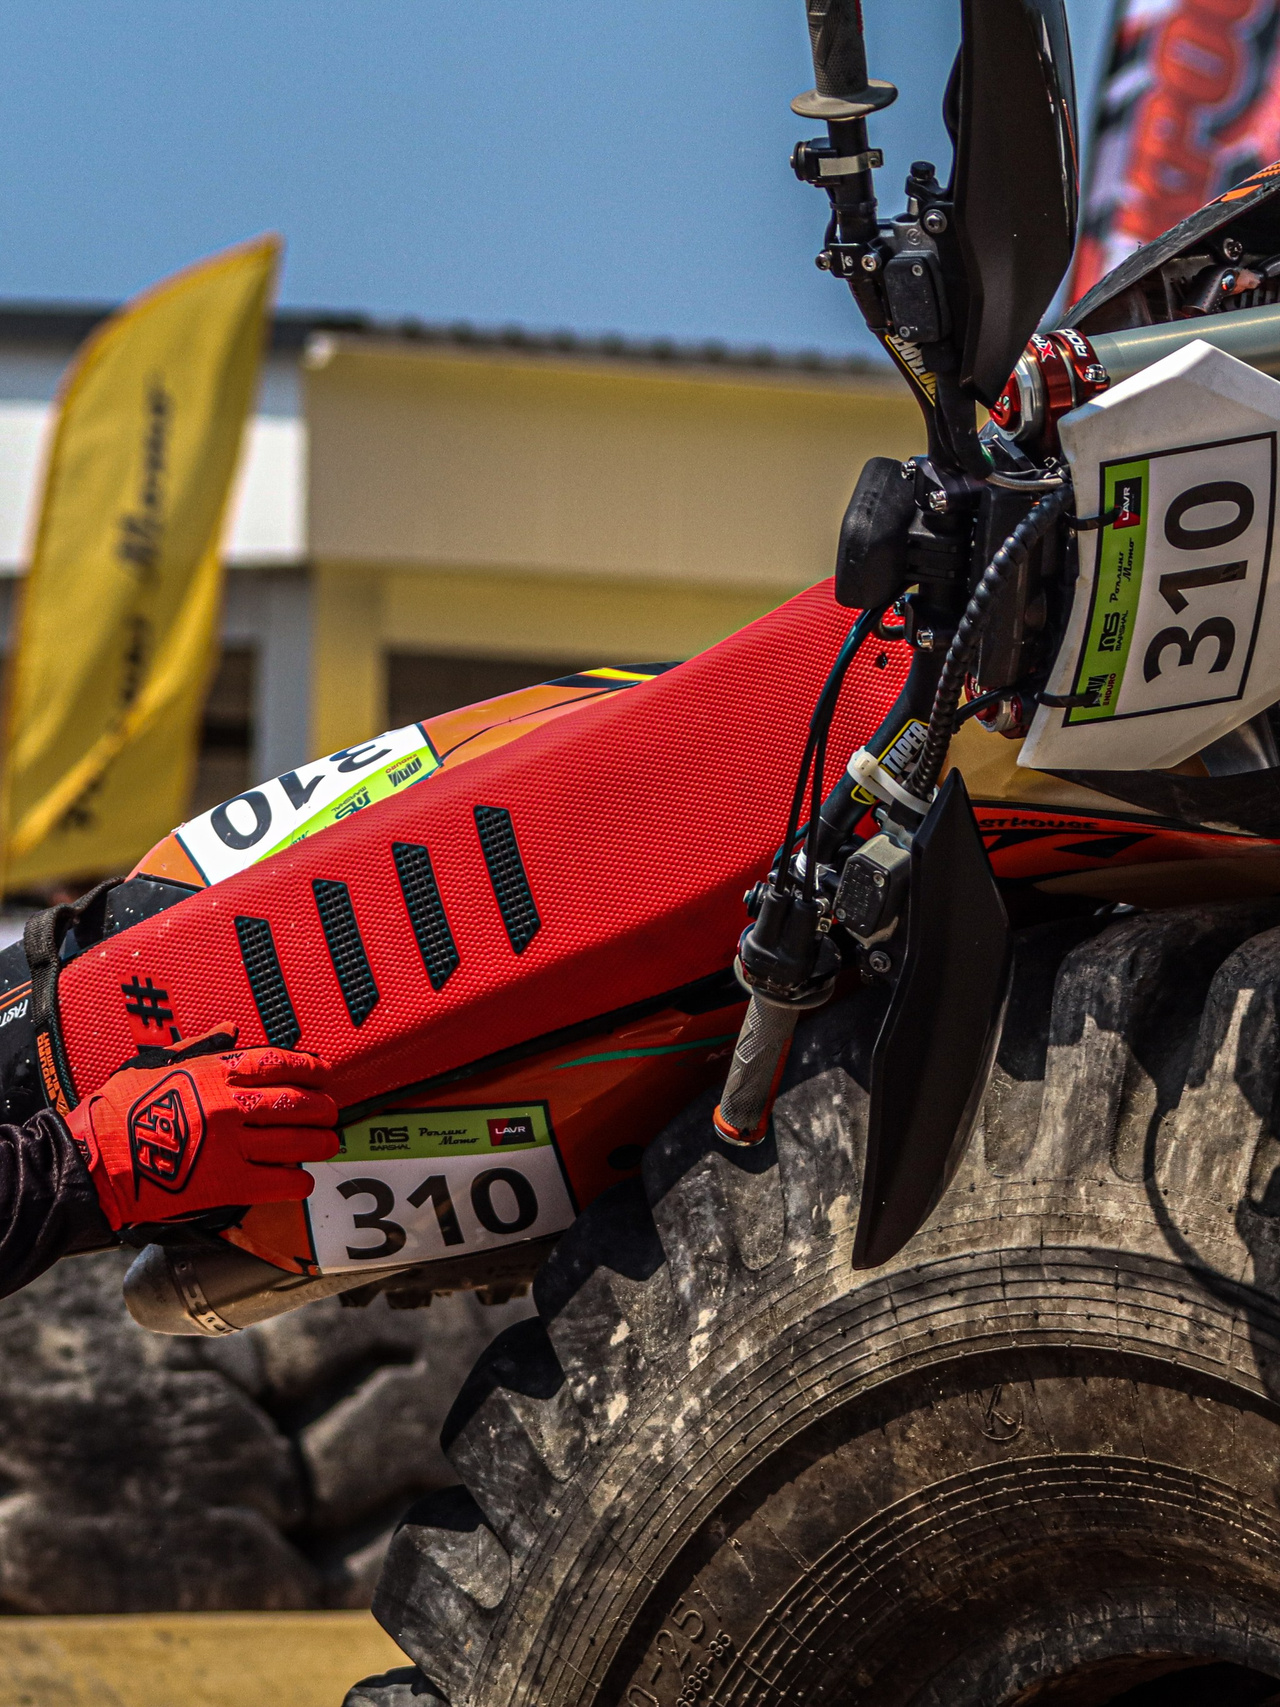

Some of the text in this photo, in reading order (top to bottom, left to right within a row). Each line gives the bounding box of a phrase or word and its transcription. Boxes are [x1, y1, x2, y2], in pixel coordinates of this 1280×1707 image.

[1121, 486, 1131, 521] LAVR
[1143, 480, 1255, 684] 310
[1102, 672, 1116, 707] ENDURO
[210, 744, 393, 850] 310
[979, 816, 1099, 829] STHOUSE
[494, 1125, 527, 1135] LAVR
[335, 1167, 538, 1260] 310
